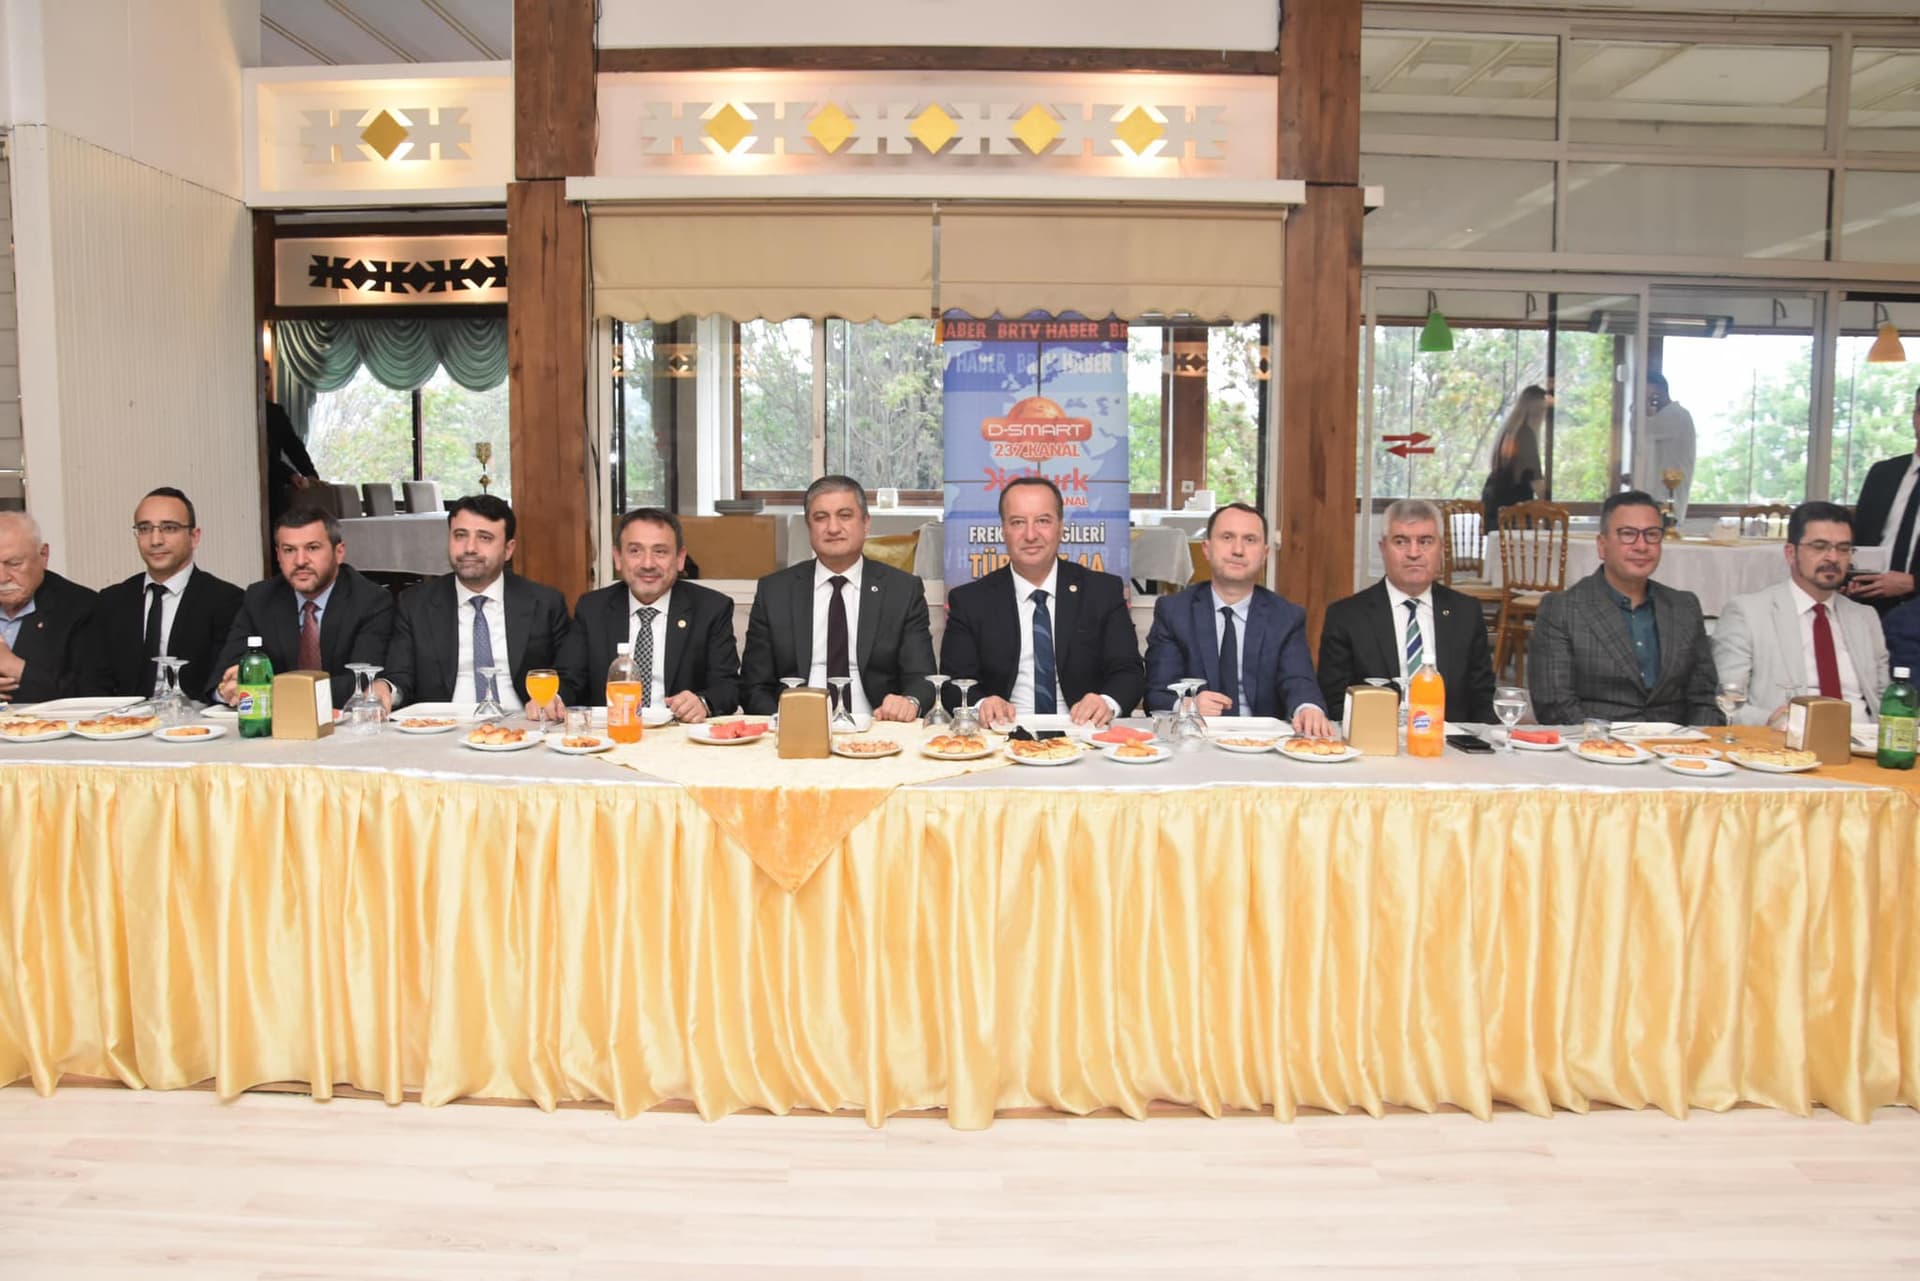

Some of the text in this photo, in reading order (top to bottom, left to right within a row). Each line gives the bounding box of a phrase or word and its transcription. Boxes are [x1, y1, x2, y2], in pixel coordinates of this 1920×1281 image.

[943, 322, 987, 339] ABER
[997, 322, 1041, 339] BRTV
[1045, 322, 1099, 338] HABER
[956, 352, 1005, 373] HABER
[987, 423, 1085, 437] D-SMART
[969, 521, 1105, 544] FREK GİLERİ
